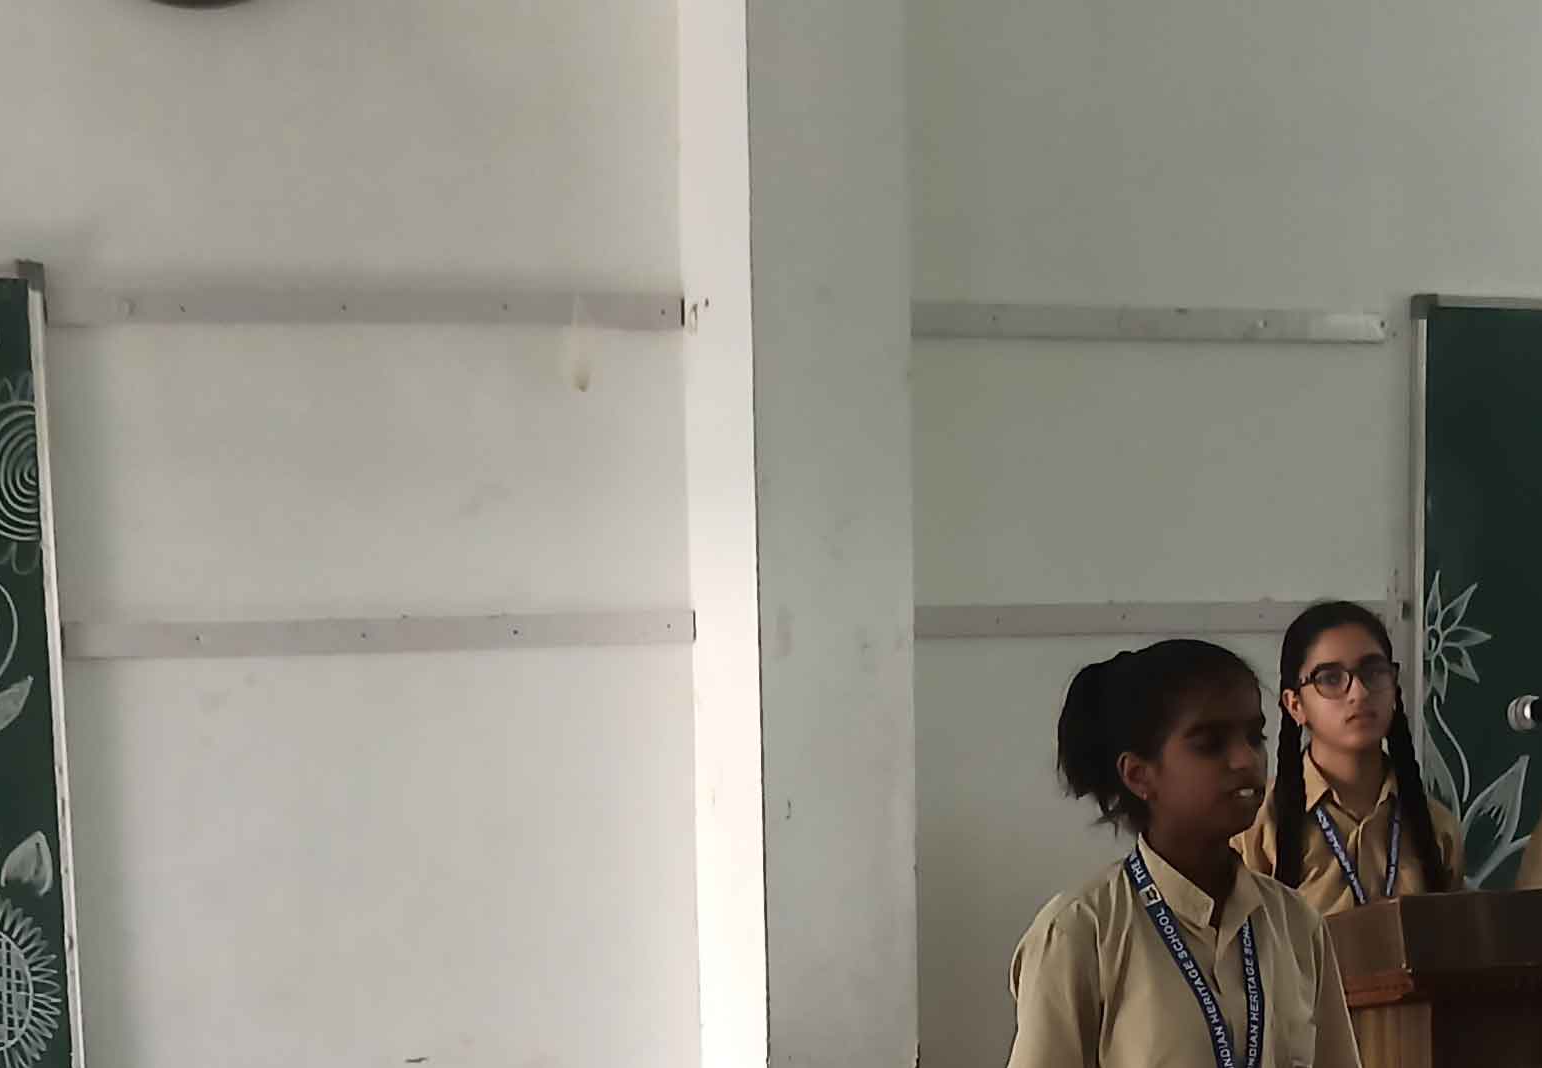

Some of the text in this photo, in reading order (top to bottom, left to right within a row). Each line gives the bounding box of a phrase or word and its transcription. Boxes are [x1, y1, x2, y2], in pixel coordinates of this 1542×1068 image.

[1156, 908, 1188, 960] SCHOOL
[1182, 960, 1220, 1024] HERITAGE
[1245, 959, 1260, 1021] HERITAGE
